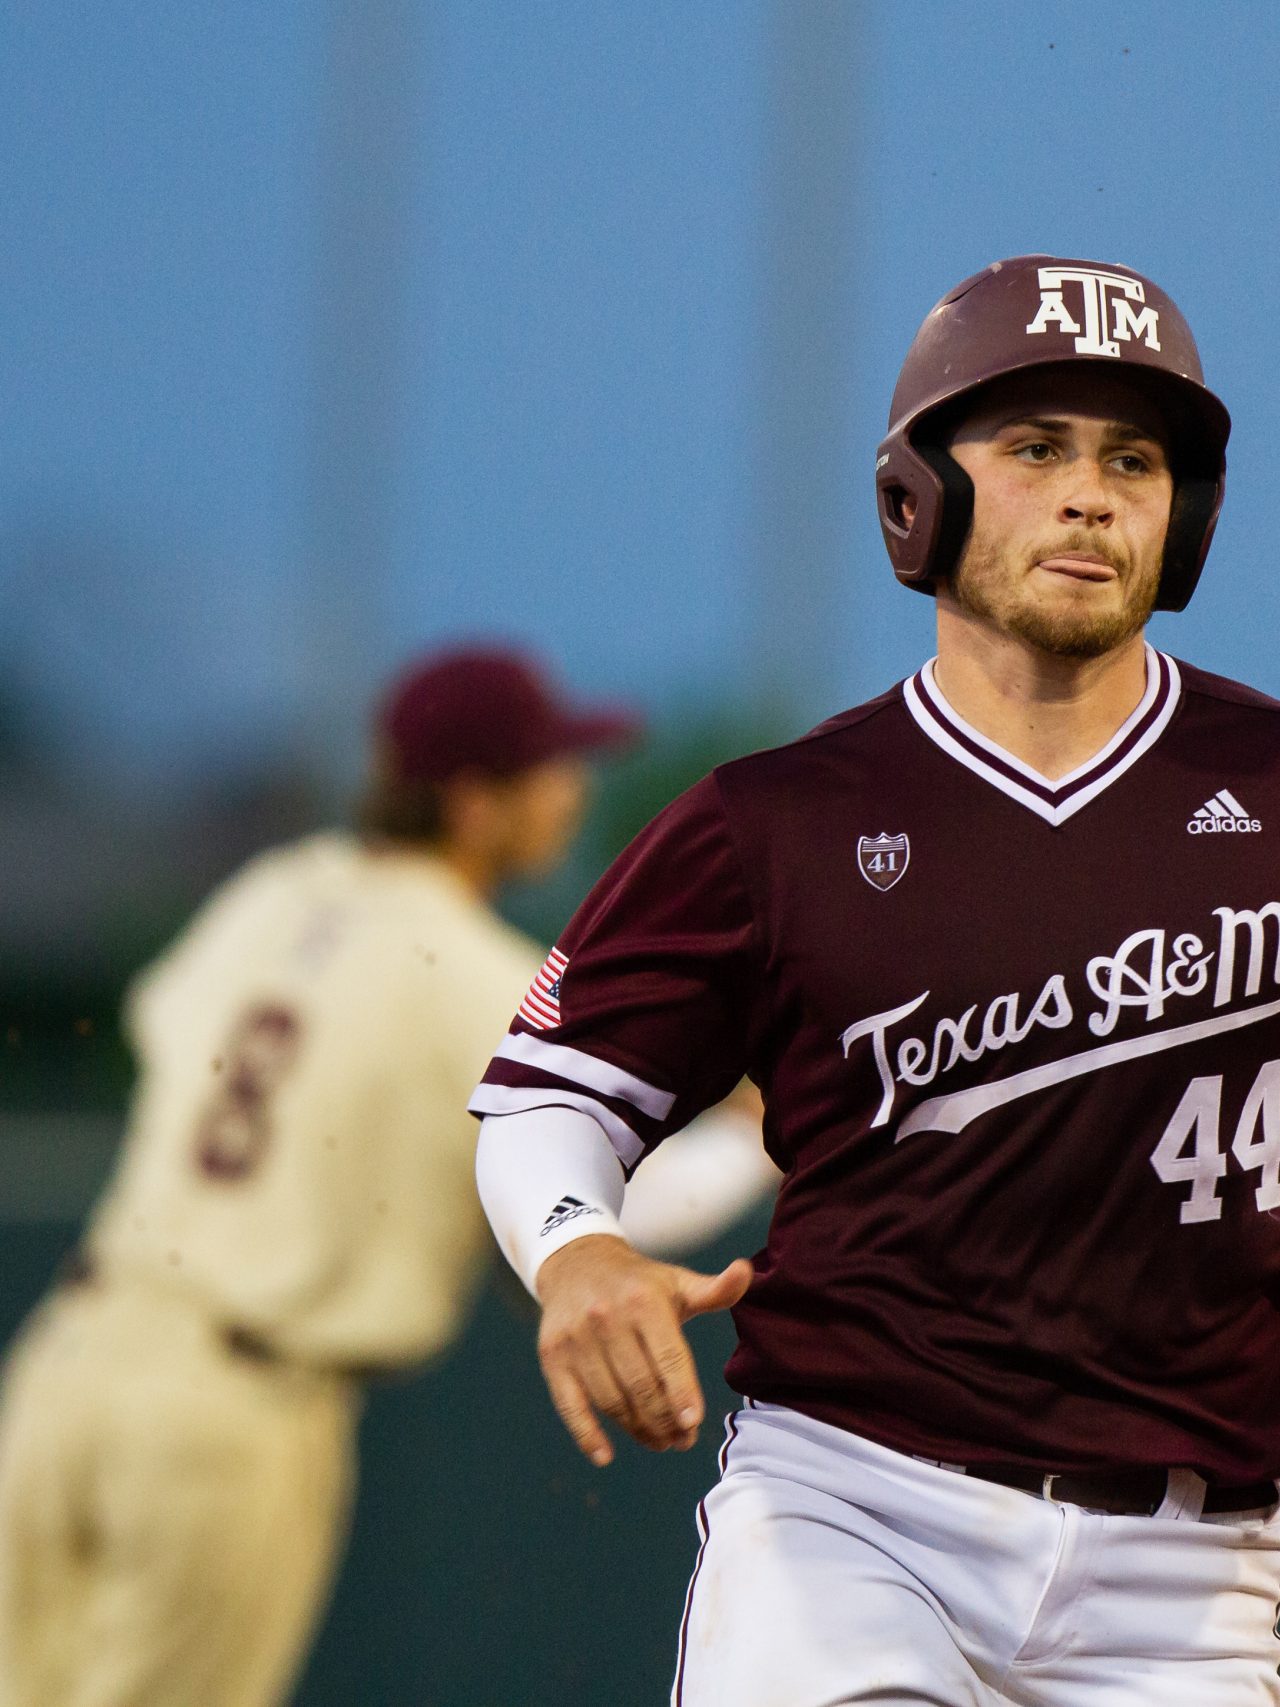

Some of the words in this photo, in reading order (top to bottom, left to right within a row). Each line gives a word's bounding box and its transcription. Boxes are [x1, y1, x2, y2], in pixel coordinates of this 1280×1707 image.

[1187, 815, 1262, 834] adidas
[867, 852, 898, 873] 41
[838, 974, 1074, 1129] Texas
